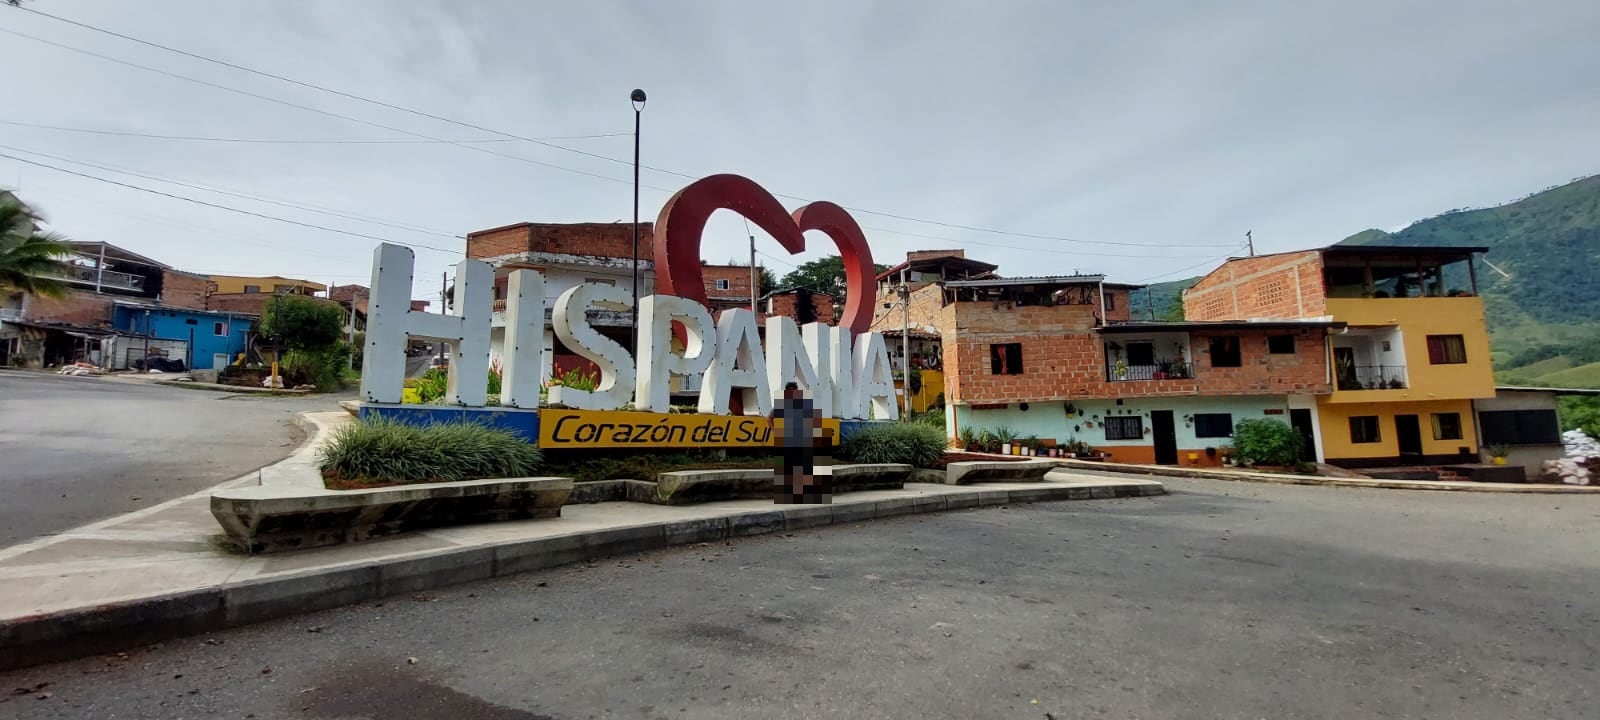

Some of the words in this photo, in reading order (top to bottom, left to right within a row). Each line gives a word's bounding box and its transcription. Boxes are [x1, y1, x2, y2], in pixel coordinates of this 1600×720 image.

[360, 242, 899, 420] HISPANIA
[552, 415, 686, 443] Corazón
[691, 419, 729, 442] del
